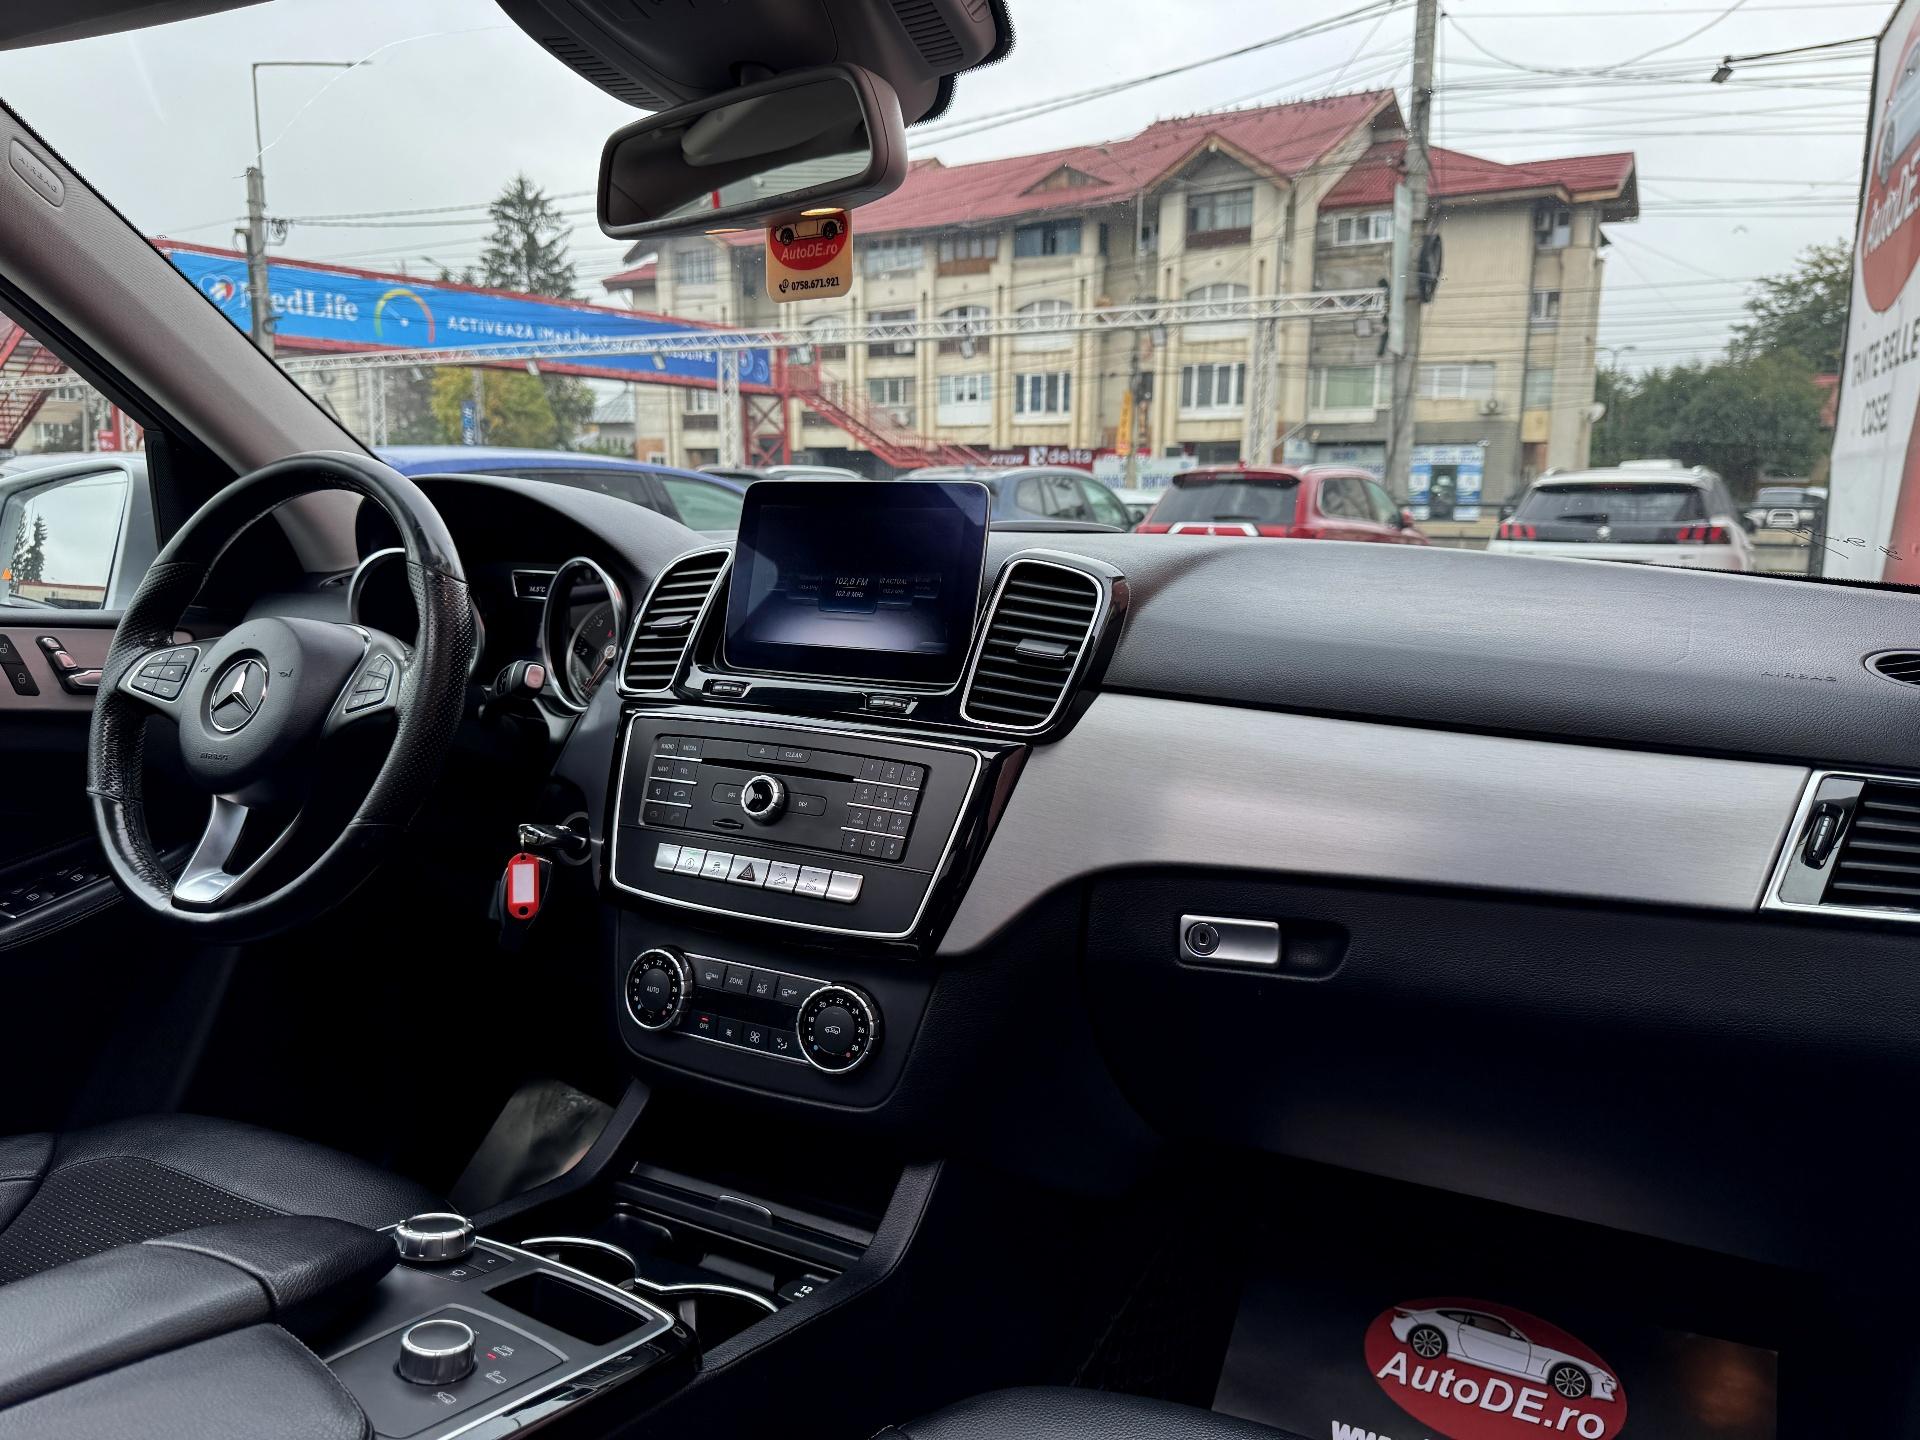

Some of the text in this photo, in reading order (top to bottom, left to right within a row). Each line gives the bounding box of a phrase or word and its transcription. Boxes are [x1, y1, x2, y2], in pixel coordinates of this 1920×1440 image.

[780, 243, 838, 261] AutoDE.ro
[791, 277, 840, 291] 0758.671.921
[1047, 449, 1093, 466] delta
[856, 577, 869, 586] FM
[785, 751, 802, 759] CLEAR
[729, 976, 744, 986] ZONE
[646, 985, 660, 994] AUTO
[1376, 1351, 1606, 1440] AutoDE.ro
